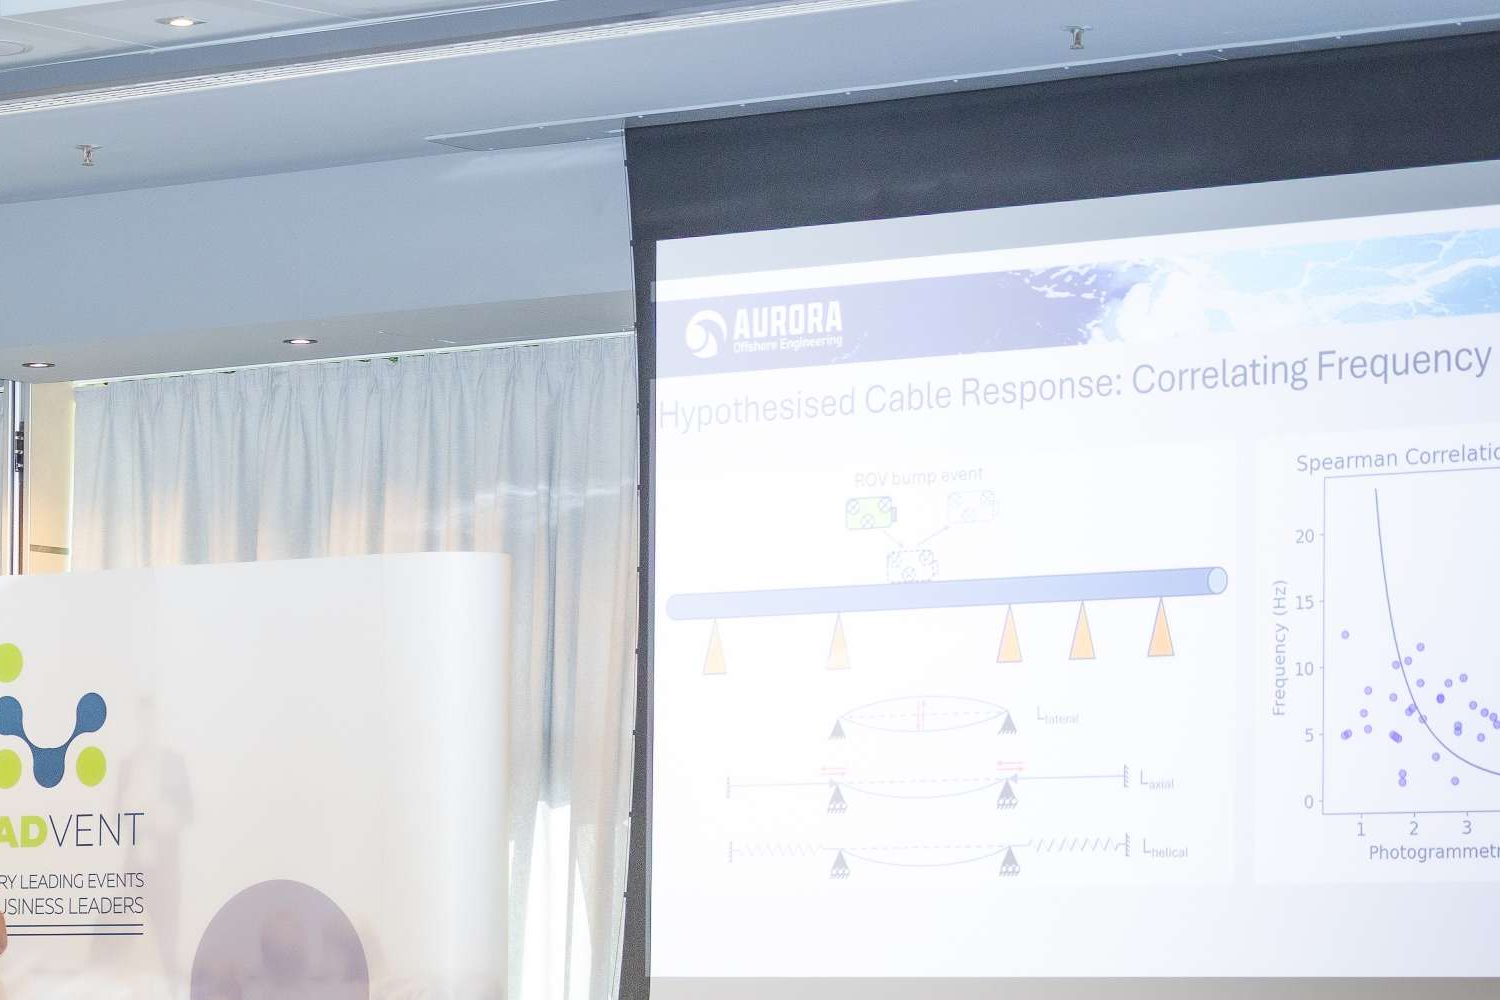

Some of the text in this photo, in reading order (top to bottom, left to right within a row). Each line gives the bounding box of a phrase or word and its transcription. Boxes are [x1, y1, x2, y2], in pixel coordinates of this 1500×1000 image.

[733, 300, 843, 340] AURORA
[733, 333, 843, 353] Offshore Engineering
[659, 346, 1492, 434] Hypothesised Cable Response: Correlating Frequency
[1297, 452, 1398, 475] Spearman
[1295, 529, 1314, 544] 20
[1296, 595, 1314, 609] 15
[1272, 580, 1289, 717] Frequency (Hz)
[1296, 662, 1314, 677] 10
[1305, 728, 1314, 742] 5
[1304, 795, 1314, 810] 0
[1357, 820, 1472, 837] 1 2 3
[21, 873, 84, 890] LEADING
[88, 872, 145, 889] EVENTS
[69, 896, 144, 914] LEADERS
